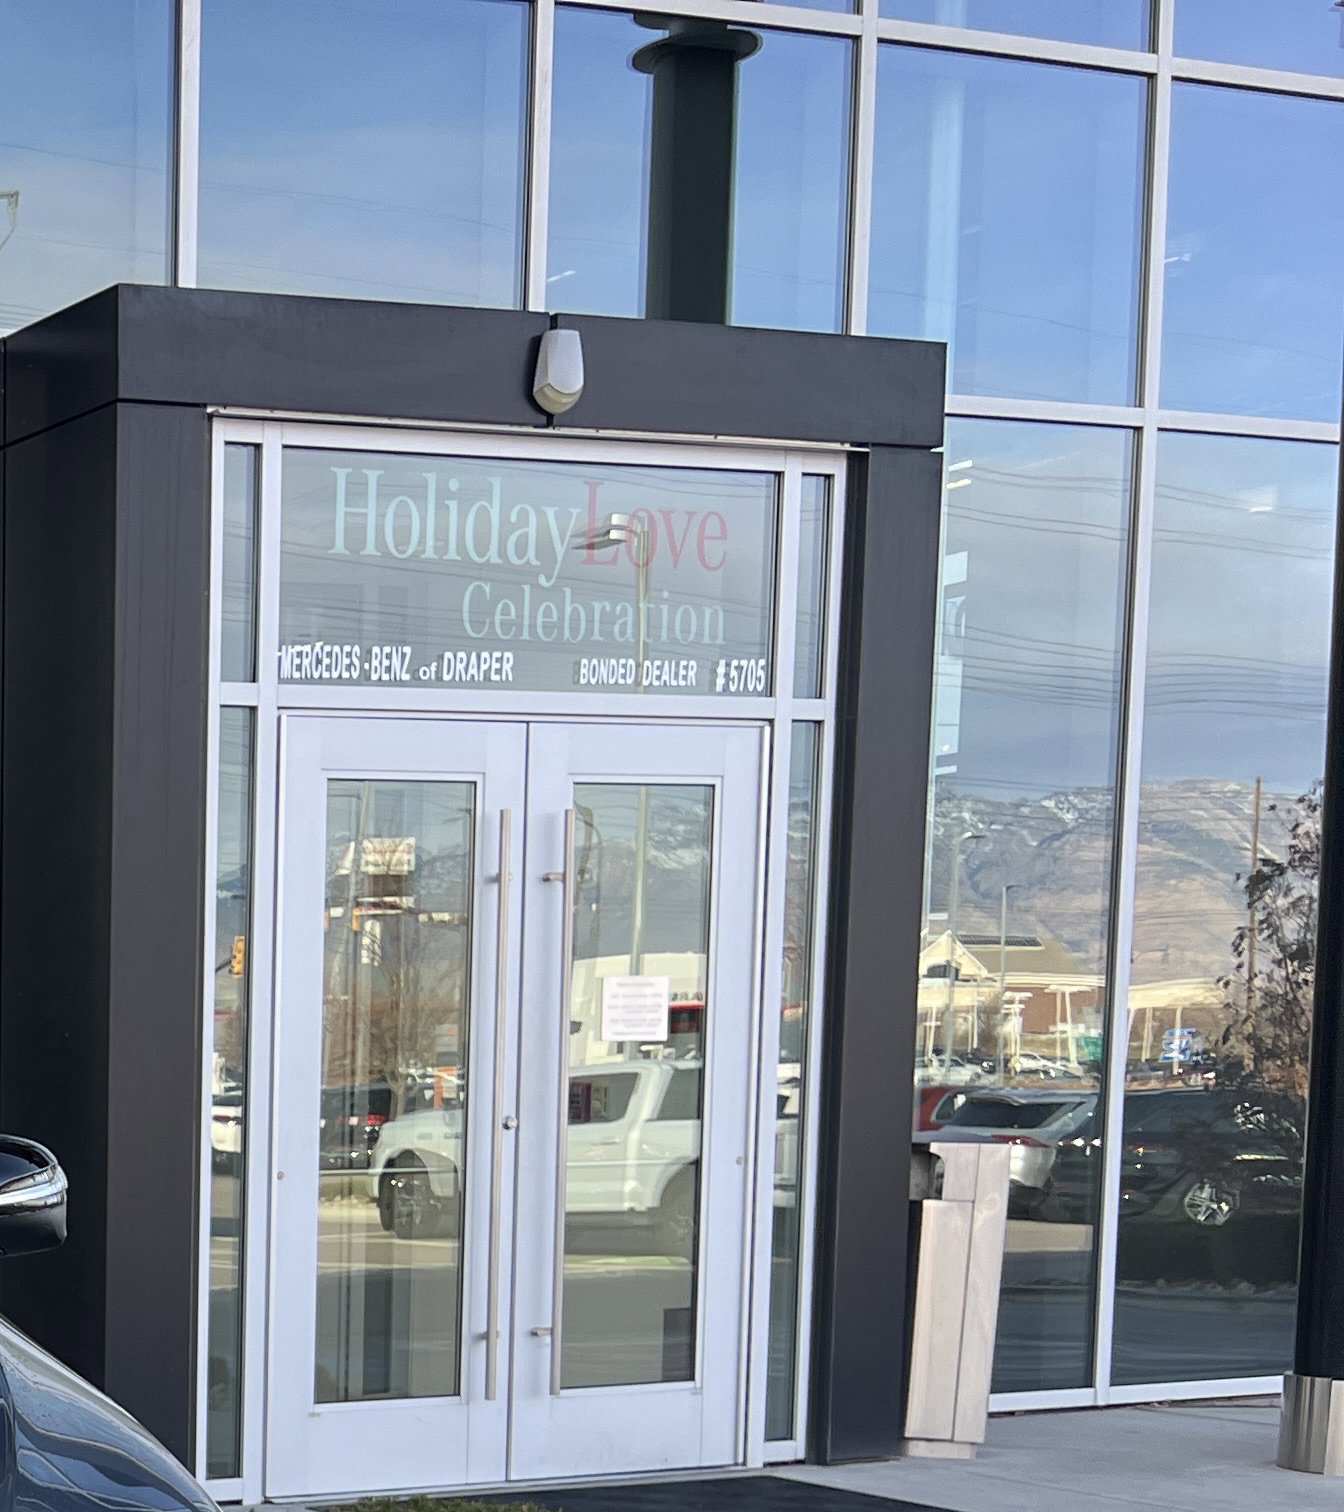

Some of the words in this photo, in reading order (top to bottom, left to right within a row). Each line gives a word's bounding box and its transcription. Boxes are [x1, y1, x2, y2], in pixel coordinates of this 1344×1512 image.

[461, 581, 726, 646] Celebration
[419, 662, 437, 681] of
[442, 650, 514, 682] DRAPER
[579, 658, 636, 685] BONDED
[642, 659, 698, 687] DEALER
